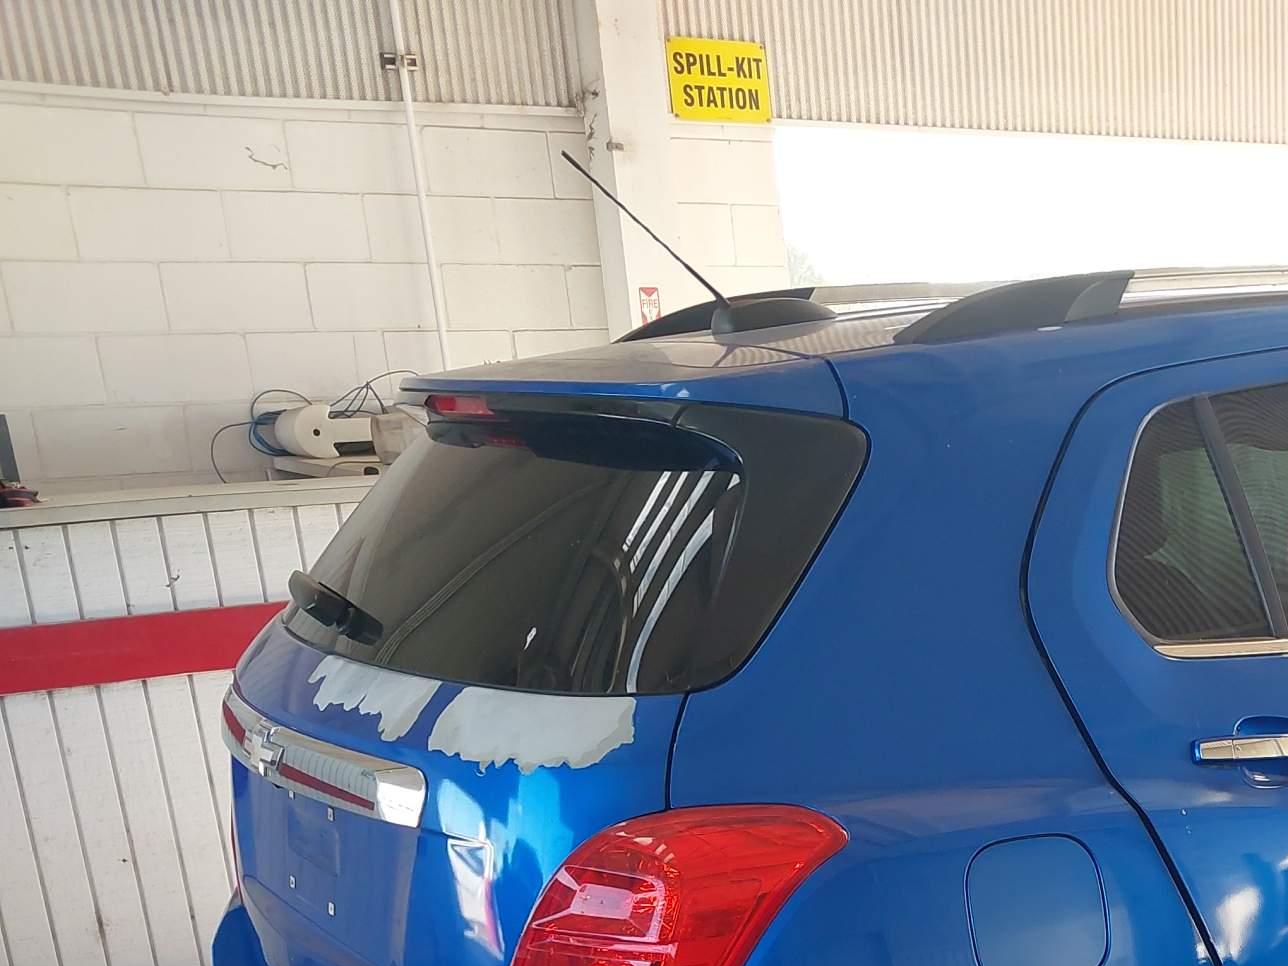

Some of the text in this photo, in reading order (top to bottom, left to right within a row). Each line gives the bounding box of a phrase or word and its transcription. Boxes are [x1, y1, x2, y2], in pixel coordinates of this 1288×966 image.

[672, 51, 763, 80] SPILL-KIT
[682, 84, 761, 111] STATION
[641, 298, 659, 309] FIRE
